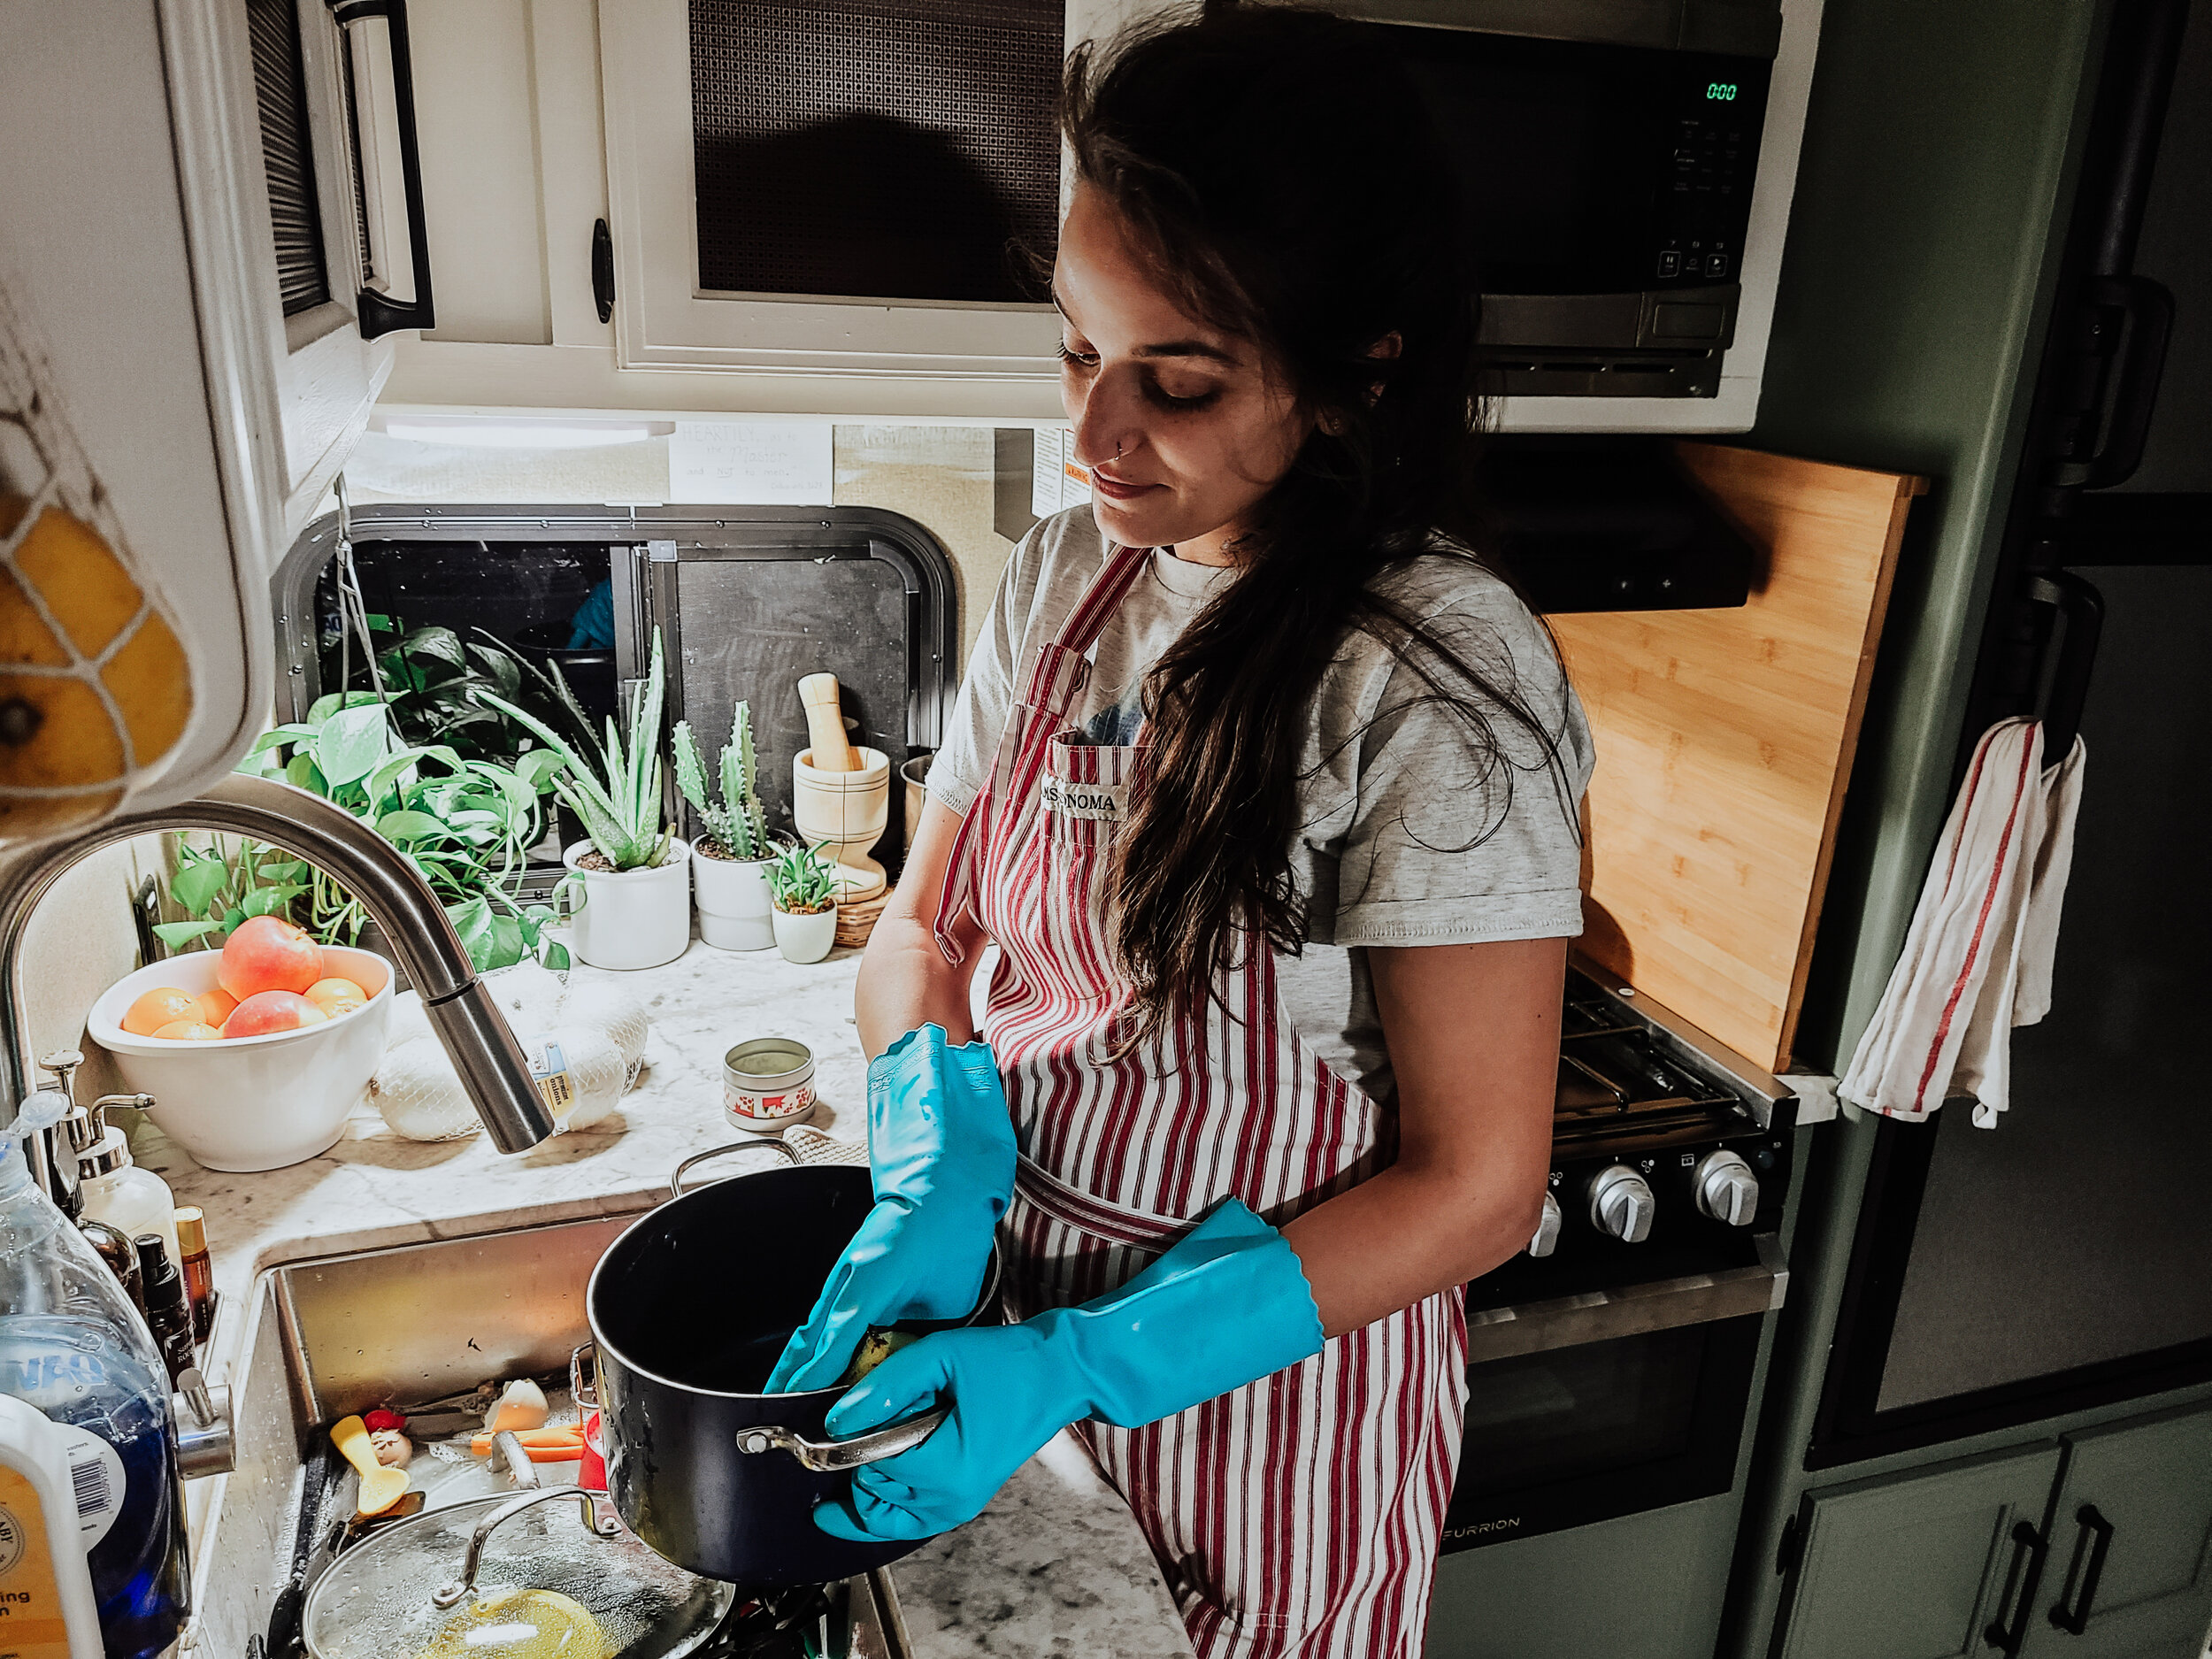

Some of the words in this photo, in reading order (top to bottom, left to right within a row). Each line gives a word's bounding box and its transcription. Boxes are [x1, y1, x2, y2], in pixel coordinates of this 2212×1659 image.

[1707, 83, 1737, 100] 0:00
[549, 1078, 562, 1105] onions
[1442, 1517, 1521, 1540] FURRION
